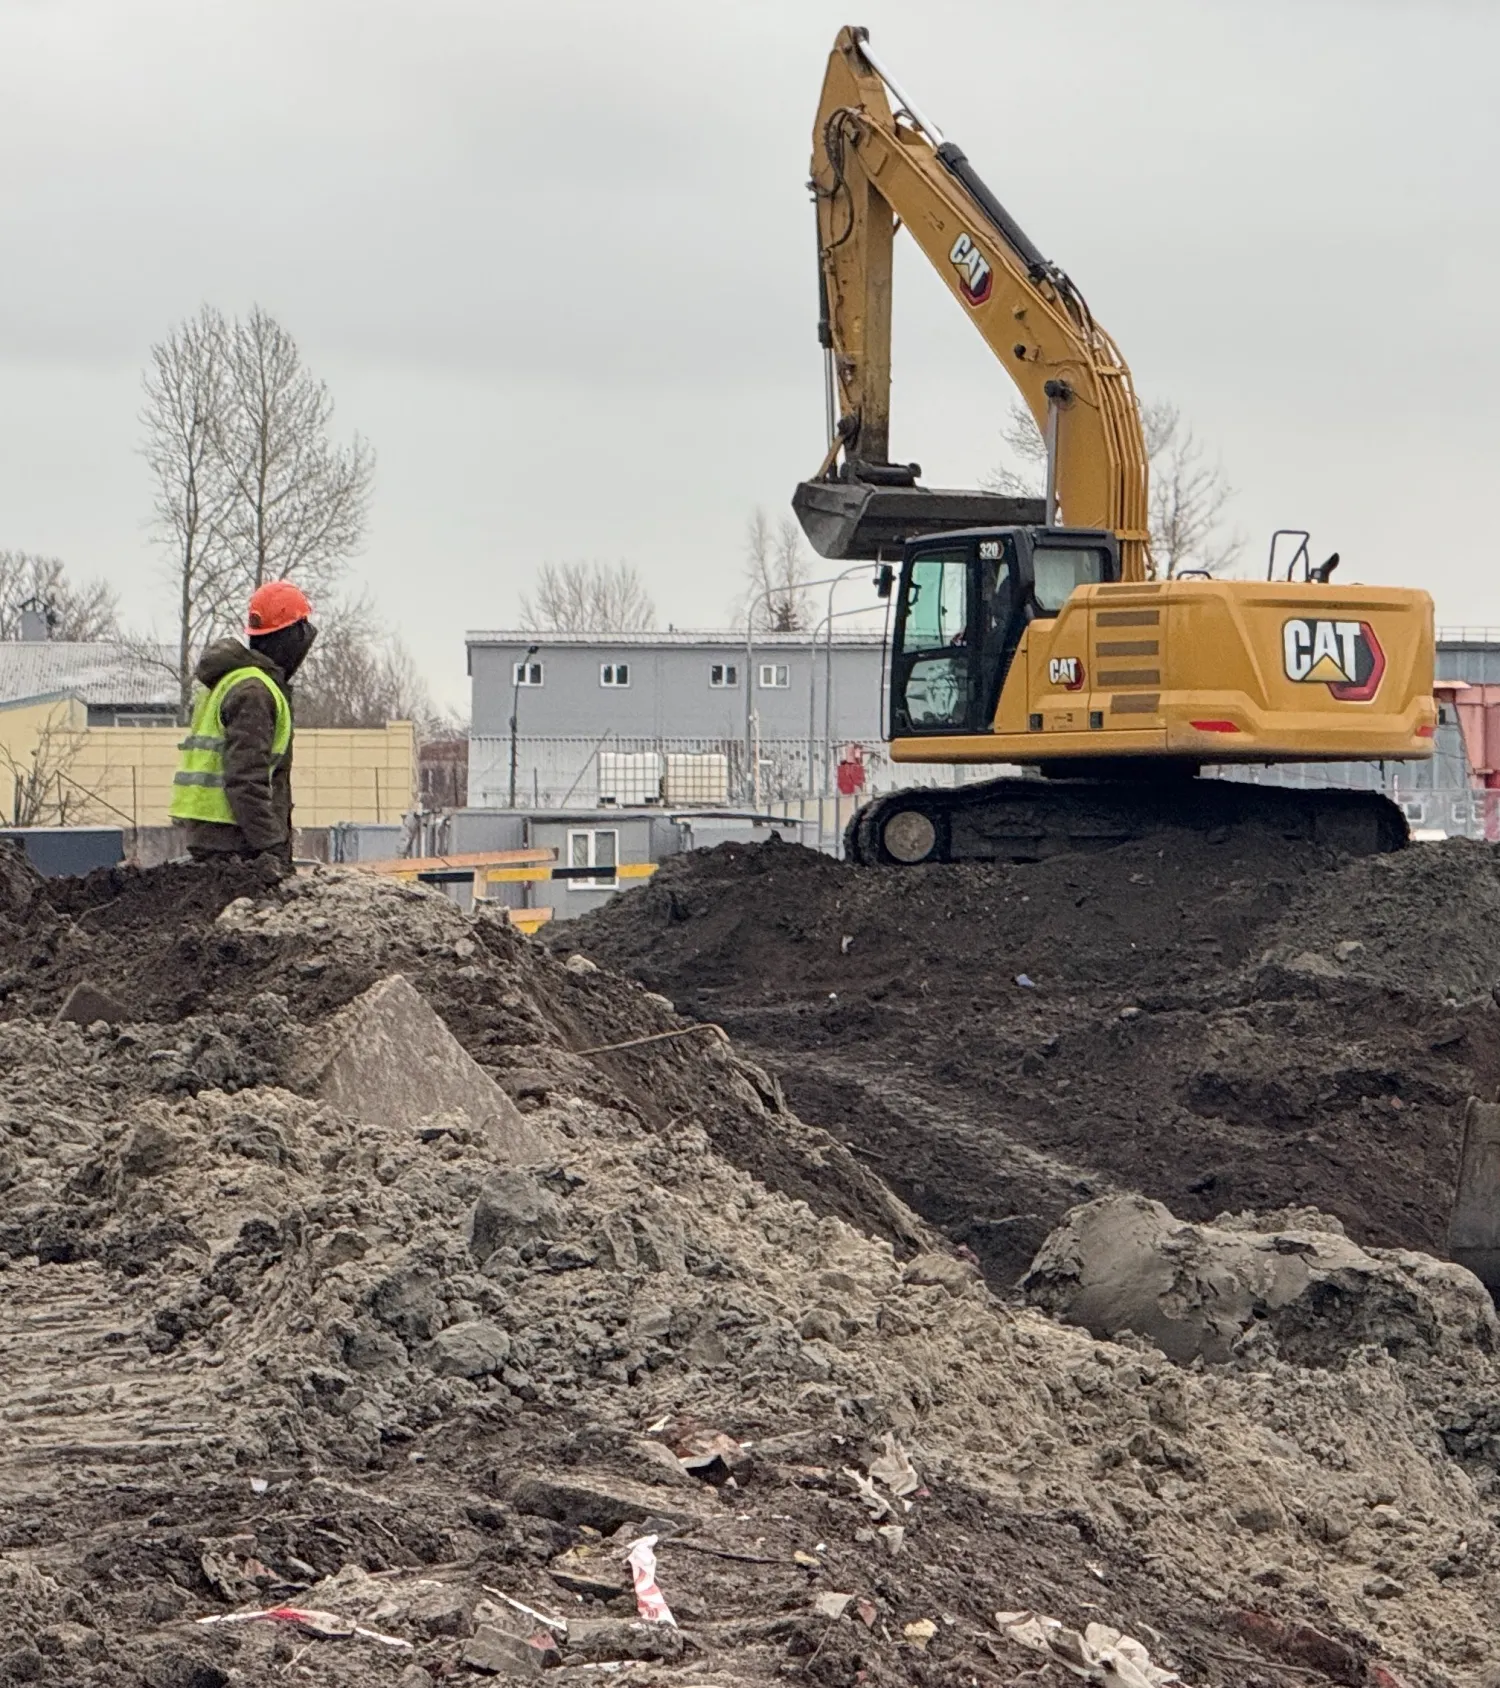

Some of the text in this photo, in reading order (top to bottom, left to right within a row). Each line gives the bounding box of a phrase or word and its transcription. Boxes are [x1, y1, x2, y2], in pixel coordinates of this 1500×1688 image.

[949, 231, 991, 292] CAT
[979, 541, 999, 558] 320
[1049, 658, 1077, 684] CAT
[1283, 619, 1361, 683] CAT
